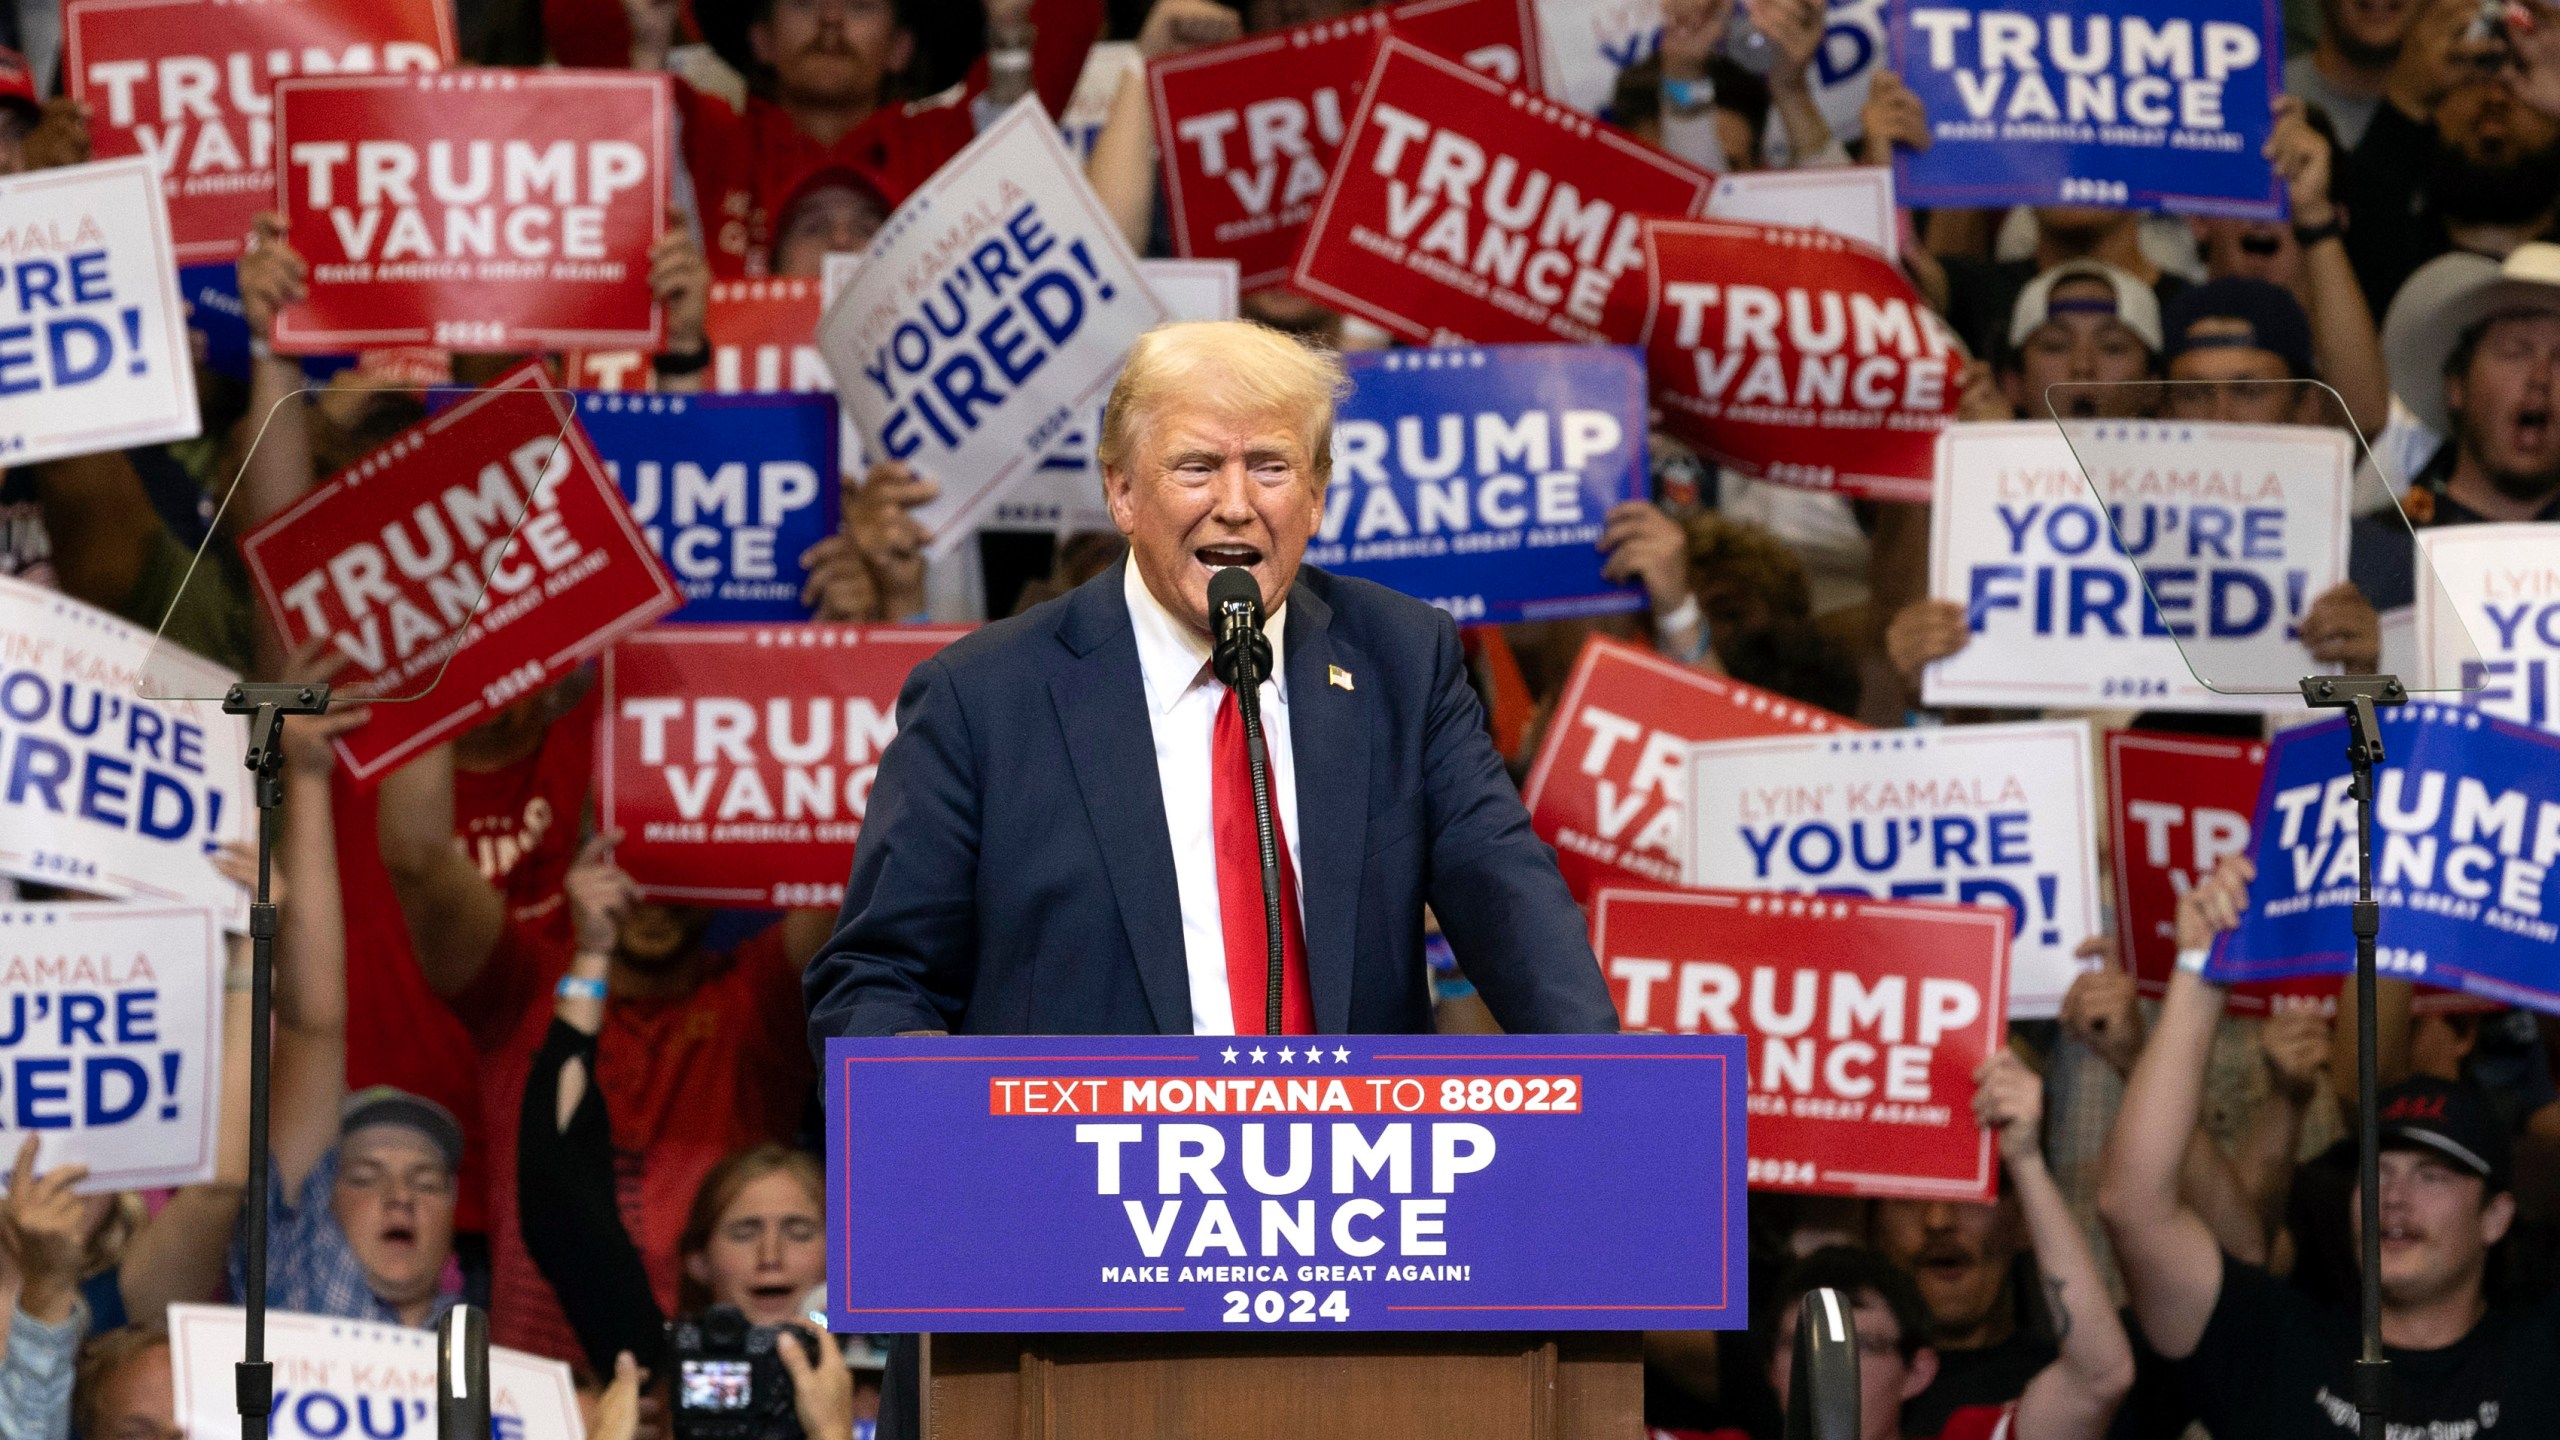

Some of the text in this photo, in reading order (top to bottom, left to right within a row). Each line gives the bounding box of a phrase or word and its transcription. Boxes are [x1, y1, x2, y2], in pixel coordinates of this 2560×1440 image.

[1911, 8, 2261, 83] TRUMP
[1954, 68, 2225, 129] VANCE
[291, 139, 646, 210] TRUMP
[330, 206, 608, 260] VANCE
[1386, 179, 1614, 326] VANCE
[865, 201, 1056, 400] YOU'RE
[880, 238, 1117, 474] FIRED!
[1693, 347, 1947, 411] VANCE
[1997, 467, 2286, 502] LYIN' KAMALA
[281, 435, 573, 640] TRUMP
[1996, 502, 2288, 562] YOU'RE
[334, 508, 583, 673] VANCE
[1967, 562, 2308, 643] FIRED!
[0, 665, 205, 774] OU'RE
[0, 734, 224, 856] RED!
[1738, 775, 2027, 822] LYIN' KAMALA
[1738, 810, 2033, 878] YOU'RE
[2292, 833, 2547, 917] VANCE
[1609, 956, 1982, 1046] TRUMP
[0, 1053, 182, 1131] ED!
[996, 1080, 1577, 1112] TEXT MONTANA TO 88022
[1075, 1123, 1497, 1195] TRUMP
[1122, 1199, 1447, 1257] VANCE
[1101, 1265, 1471, 1283] MAKE AMERICA GREAT AGAIN!
[1222, 1291, 1350, 1323] 2024
[267, 1390, 523, 1440] YOU'E
